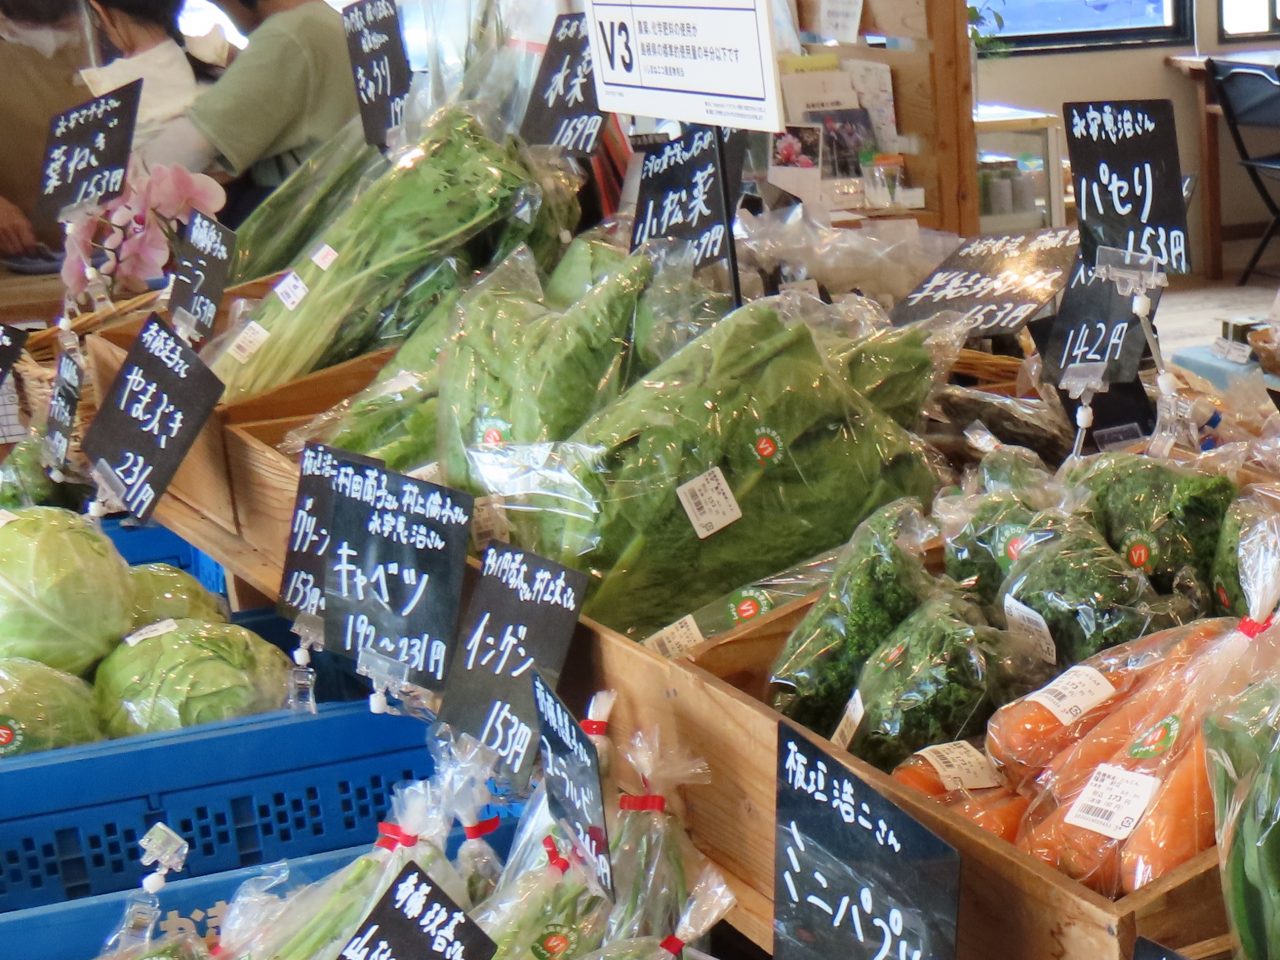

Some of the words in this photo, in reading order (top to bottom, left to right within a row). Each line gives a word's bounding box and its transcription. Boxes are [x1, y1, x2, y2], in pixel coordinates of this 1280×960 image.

[598, 20, 634, 73] V3
[357, 55, 391, 105] きゅうり
[553, 115, 603, 153] 169円
[73, 168, 125, 208] 153円
[634, 163, 716, 246] 小松菜
[1080, 162, 1154, 224] パセリ
[1125, 227, 1187, 274] 153円
[954, 303, 1039, 330] 153円
[1060, 322, 1129, 369] 142円
[120, 365, 184, 449] やまぶき
[114, 452, 156, 519] 231円
[333, 541, 430, 617] キャベツ
[466, 611, 535, 677] インゲン
[468, 700, 533, 774] 153円
